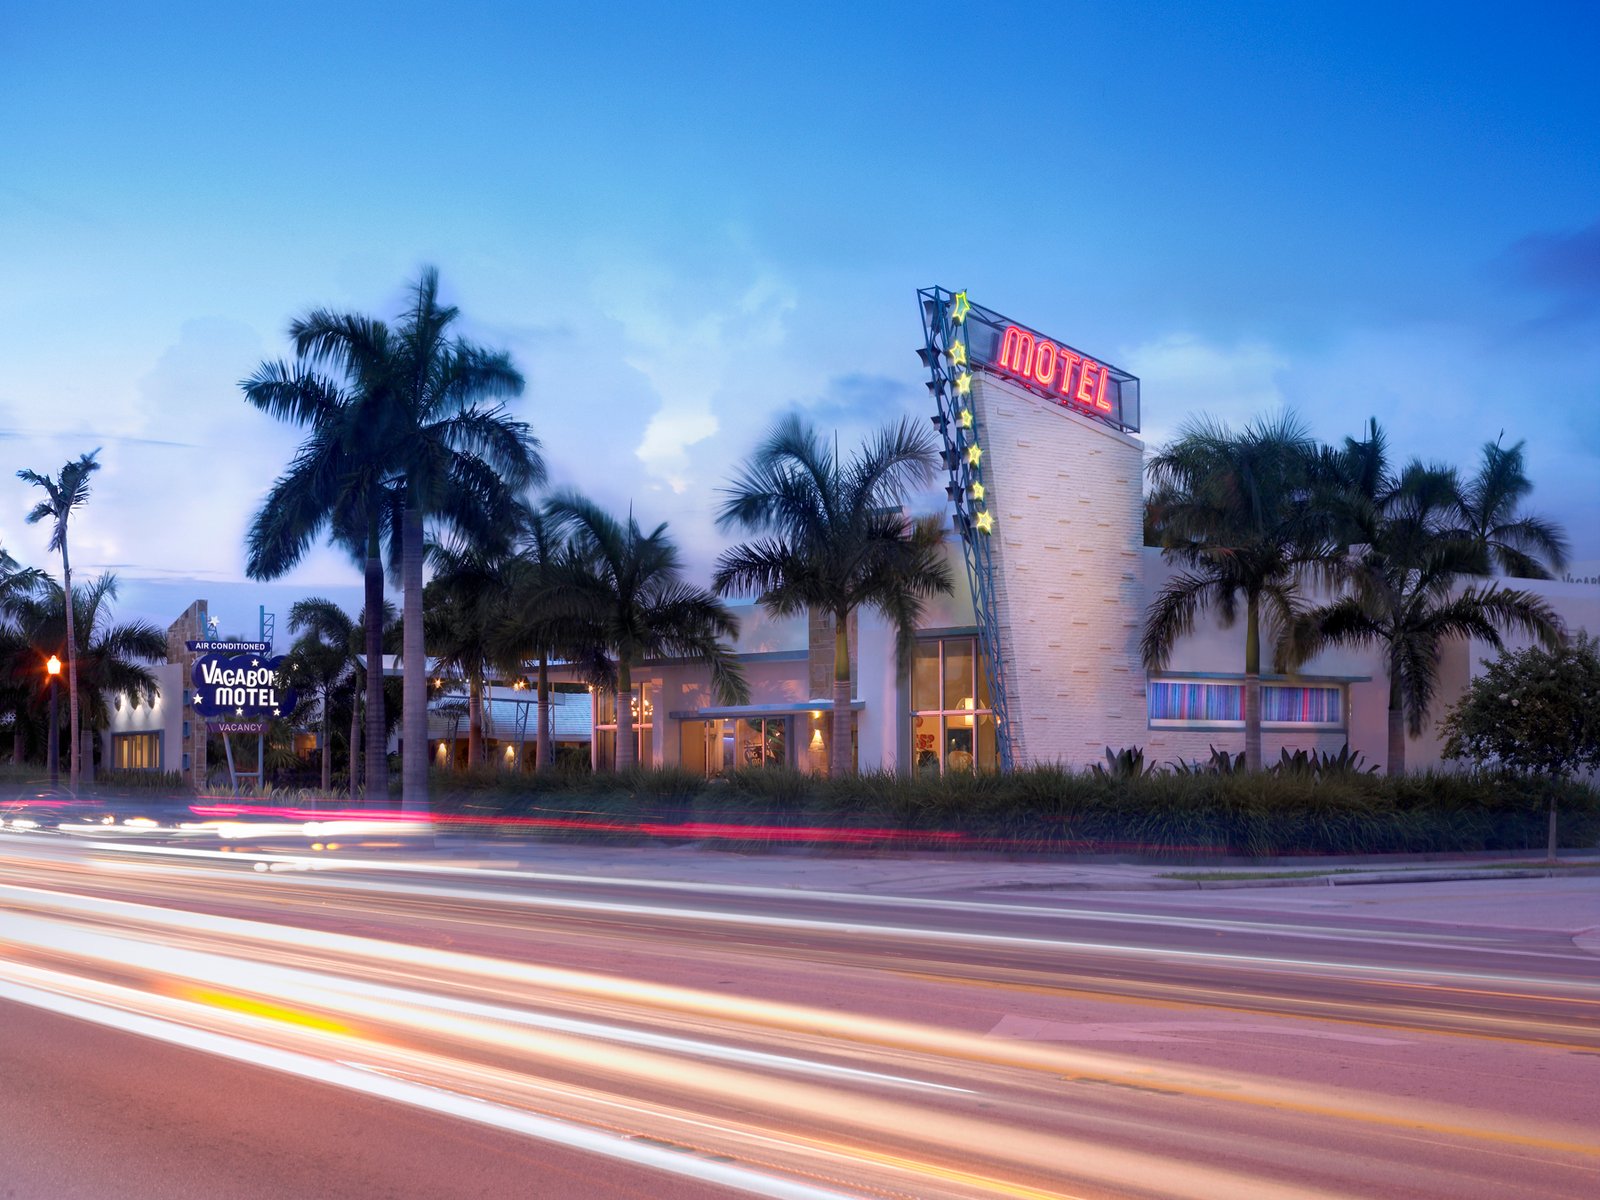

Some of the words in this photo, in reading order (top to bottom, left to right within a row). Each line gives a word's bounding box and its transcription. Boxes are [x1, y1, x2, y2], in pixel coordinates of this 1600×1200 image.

[999, 326, 1112, 412] MOTEL
[201, 660, 290, 689] VAGABON
[215, 687, 279, 706] MOTEL
[219, 723, 263, 732] VACANCY
